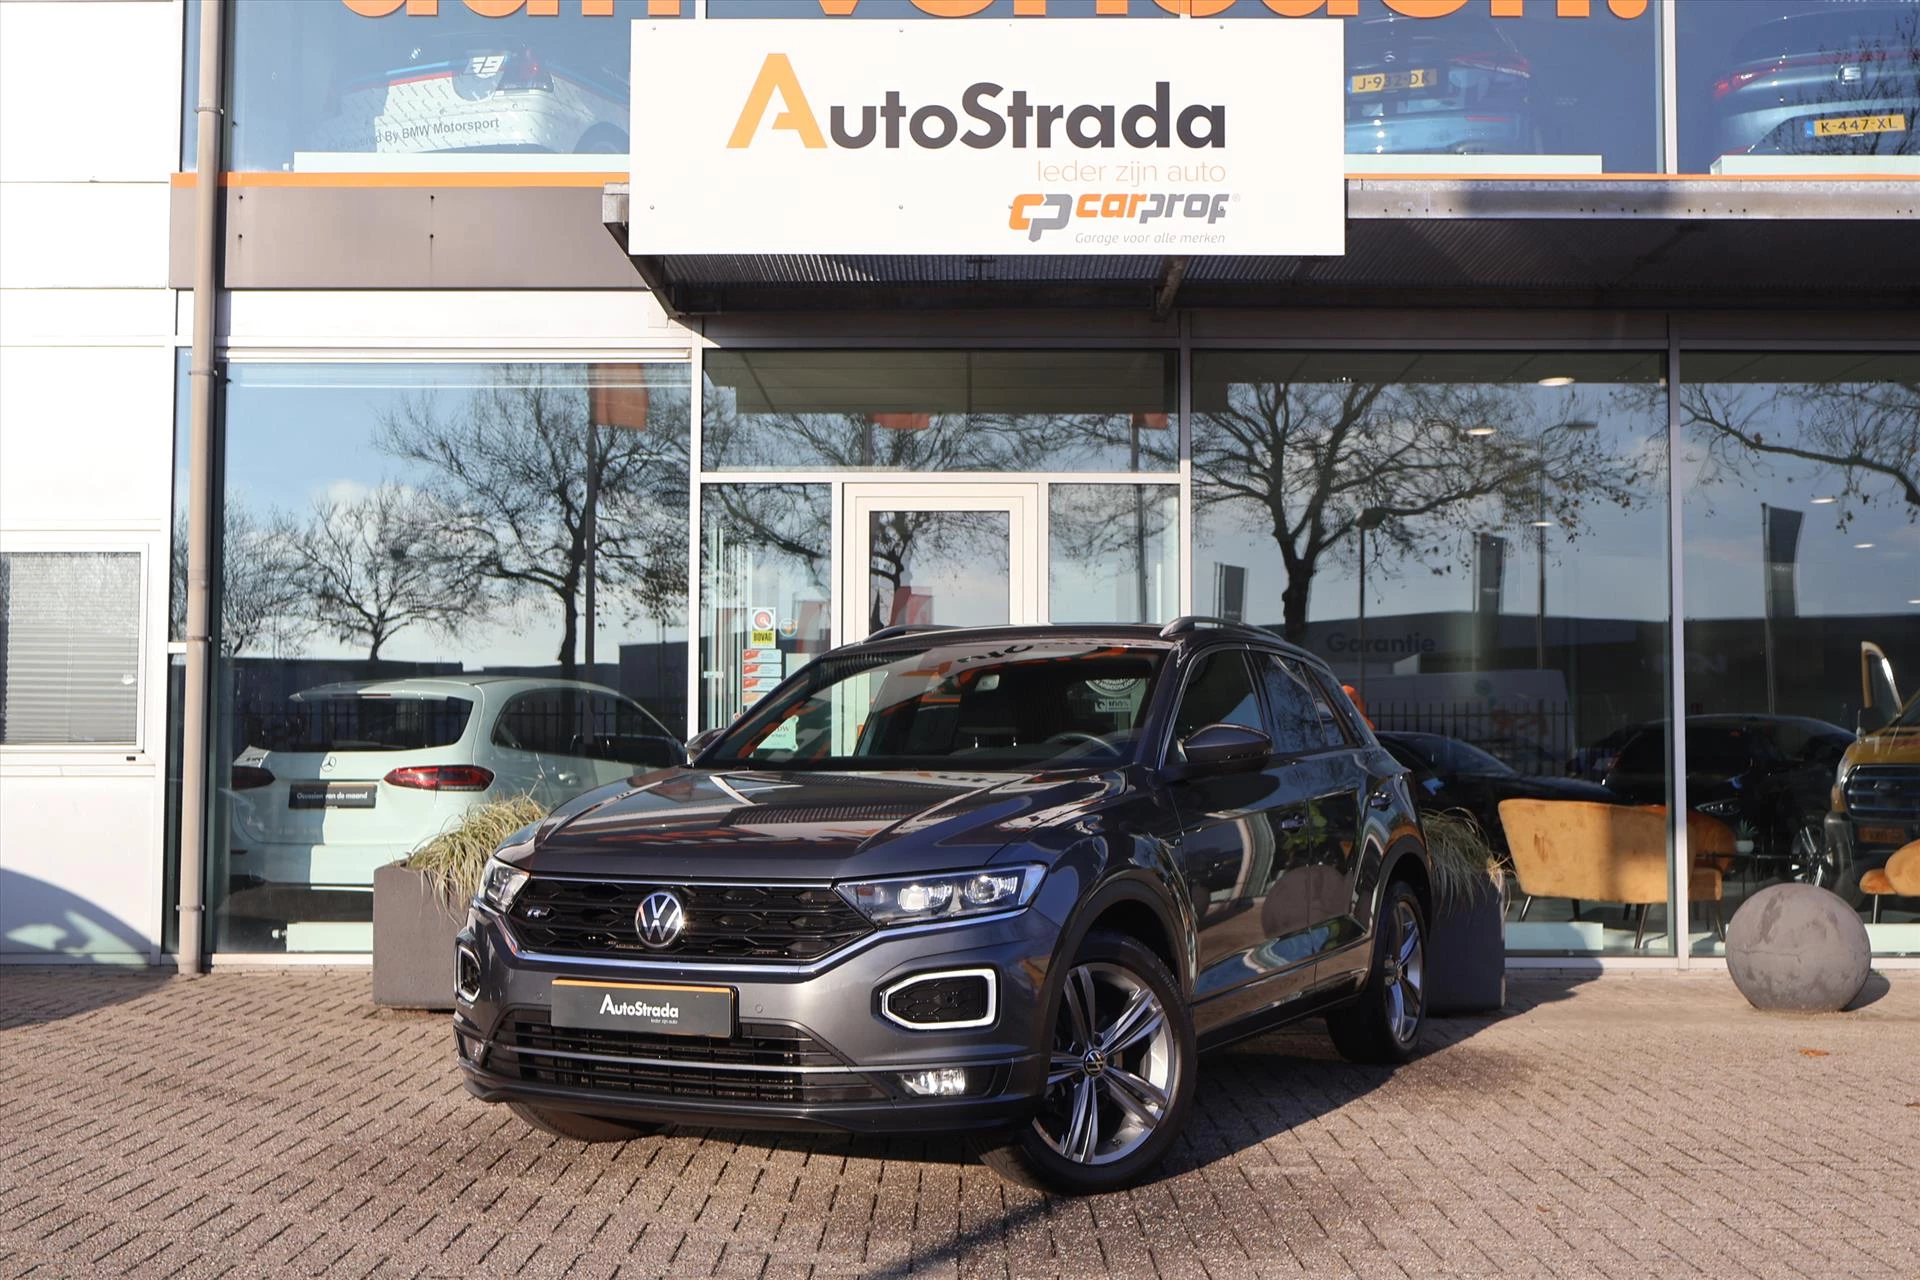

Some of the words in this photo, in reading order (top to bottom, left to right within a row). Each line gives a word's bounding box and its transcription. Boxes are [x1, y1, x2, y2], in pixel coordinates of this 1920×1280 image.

[726, 53, 1225, 150] AutoStrada
[385, 129, 400, 144] By
[402, 123, 430, 140] BMW
[433, 117, 500, 136] Motorsport
[1820, 117, 1898, 133] K-447-XL
[1115, 160, 1158, 187] zijn
[1167, 163, 1226, 182] auto
[1076, 193, 1230, 224] carprof
[1075, 232, 1119, 246] Garage
[1123, 234, 1150, 244] voor
[1154, 232, 1176, 244] alle
[1180, 232, 1225, 244] merken
[753, 632, 773, 642] BOVAG
[1327, 632, 1436, 653] Garantie
[325, 792, 336, 800] van
[336, 791, 345, 800] de
[346, 791, 368, 800] maand
[599, 993, 679, 1018] AutoStrada
